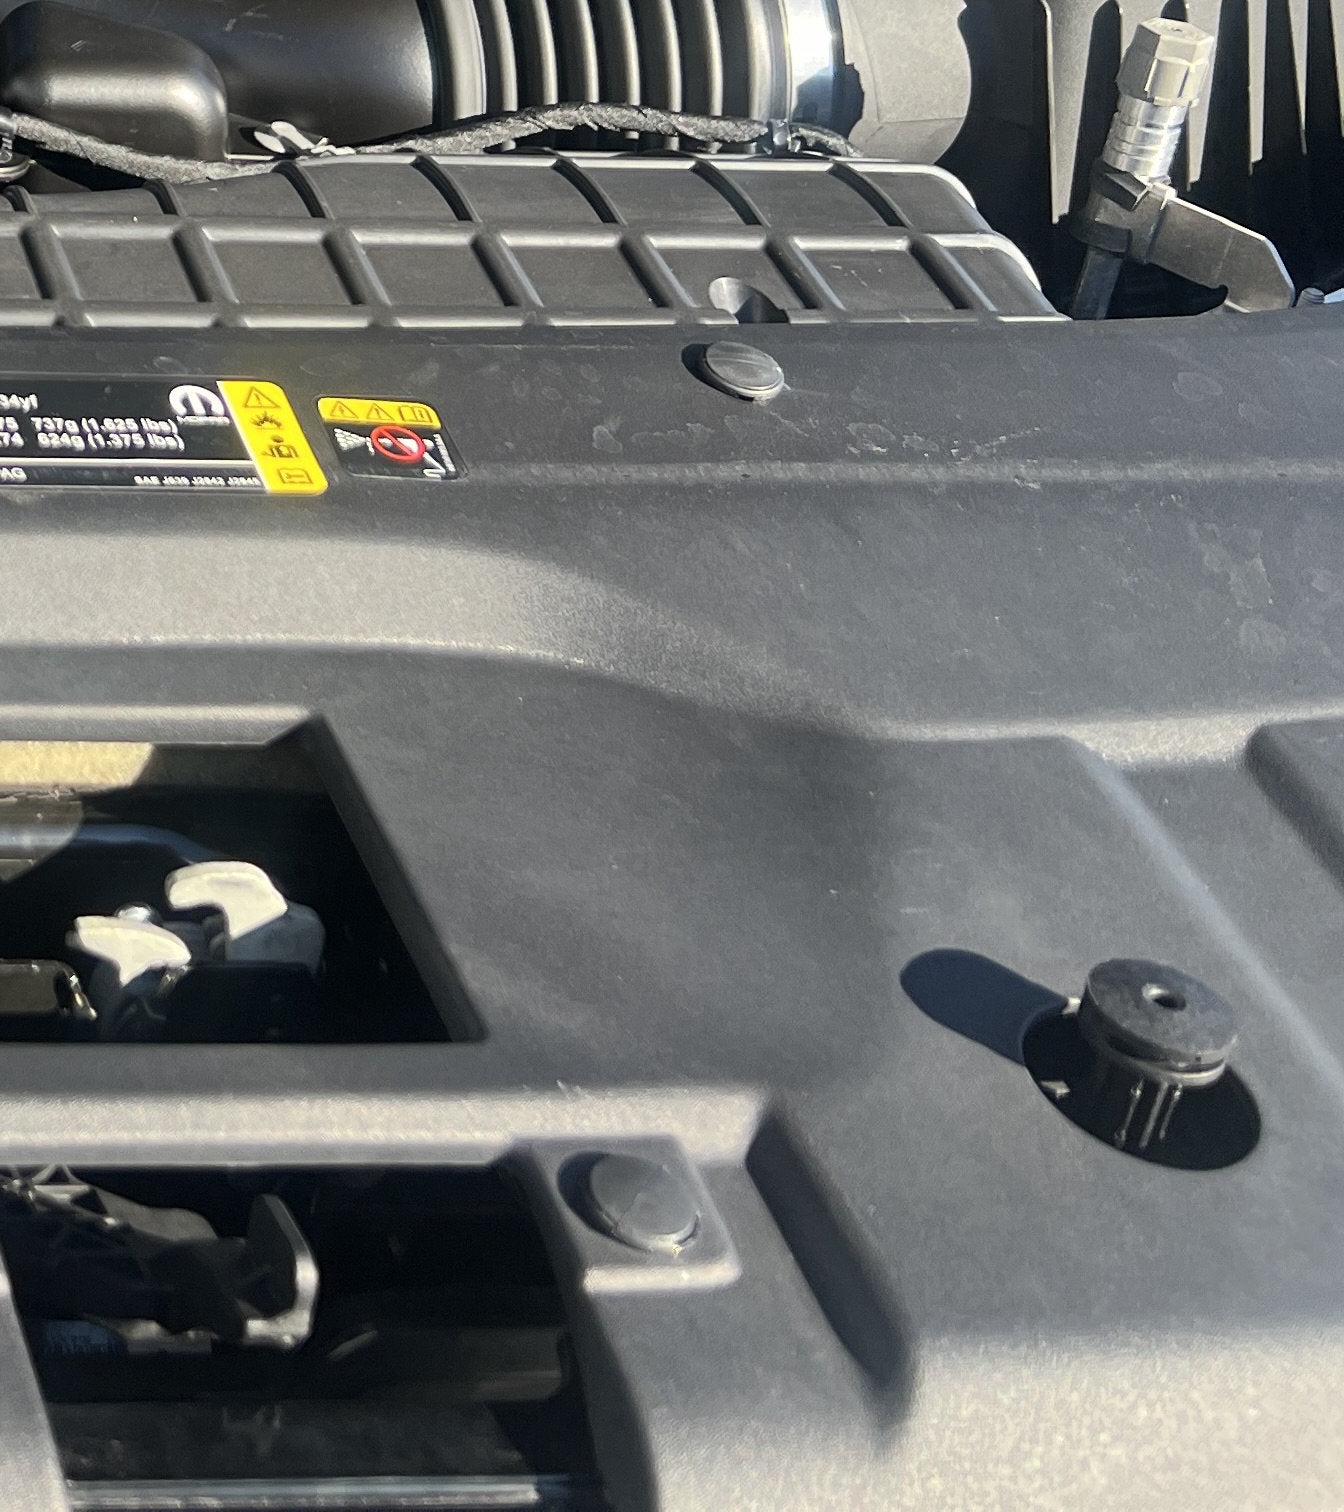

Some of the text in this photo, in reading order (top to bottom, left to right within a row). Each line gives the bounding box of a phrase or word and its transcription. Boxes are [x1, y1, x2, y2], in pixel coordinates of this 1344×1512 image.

[30, 417, 80, 435] 737g
[140, 417, 179, 435] lbs)
[37, 432, 85, 451] 624g
[87, 432, 146, 451] (1.375
[146, 433, 185, 452] lbs)
[133, 475, 161, 487] SAE
